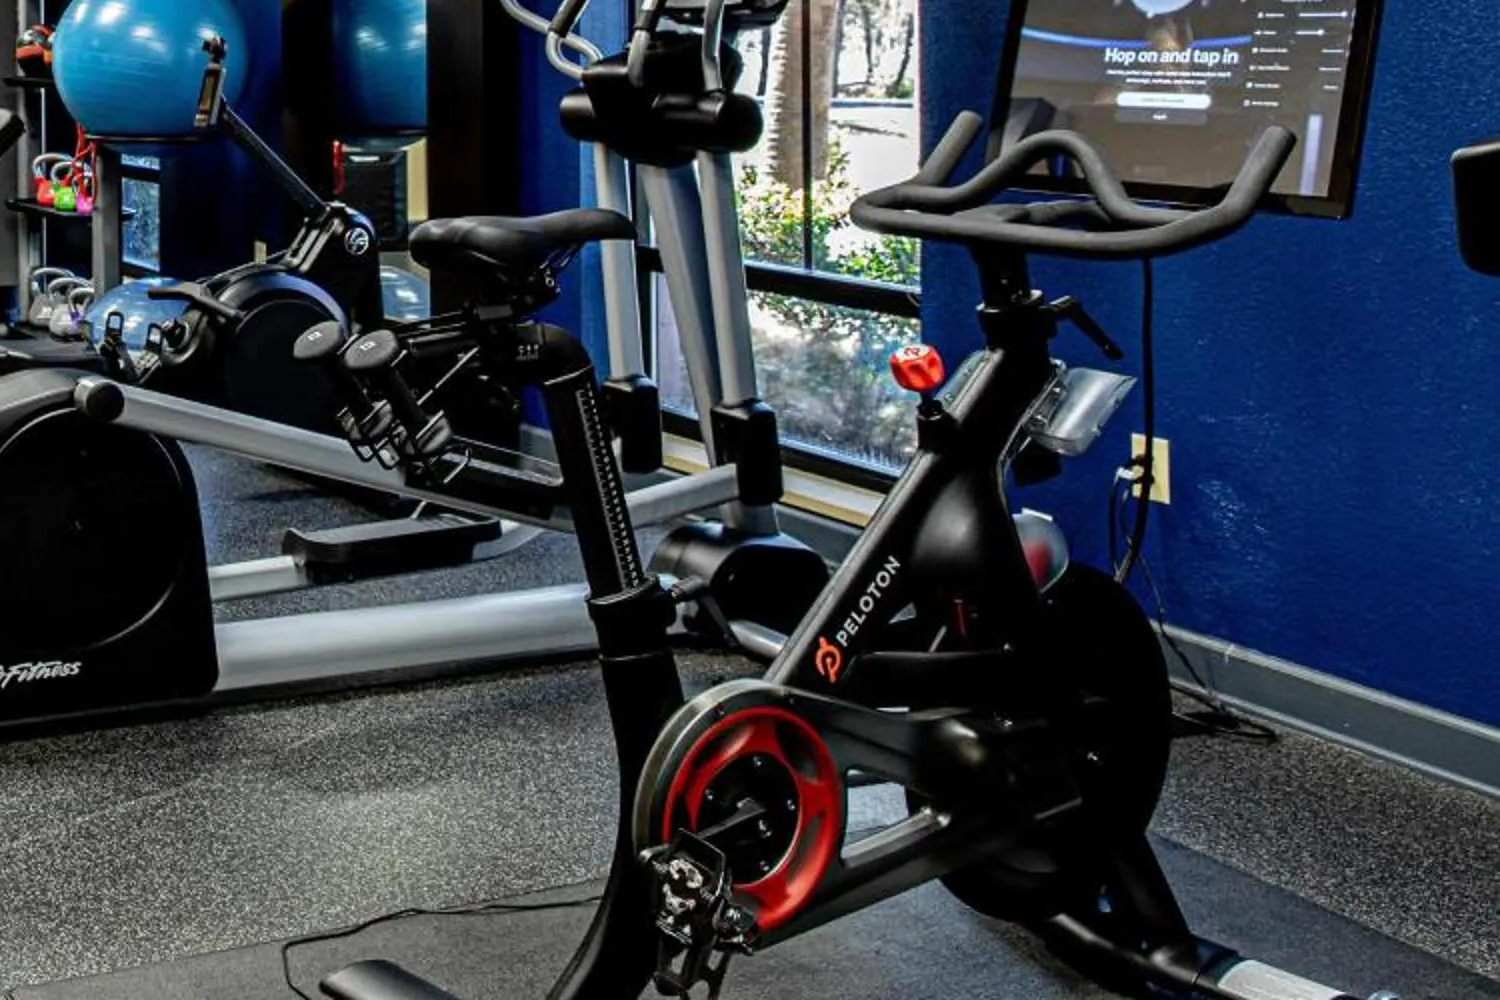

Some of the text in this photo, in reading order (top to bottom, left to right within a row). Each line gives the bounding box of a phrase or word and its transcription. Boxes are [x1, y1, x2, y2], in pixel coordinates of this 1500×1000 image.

[1104, 48, 1239, 66] Hop on and tap in
[835, 555, 901, 647] PELOTON
